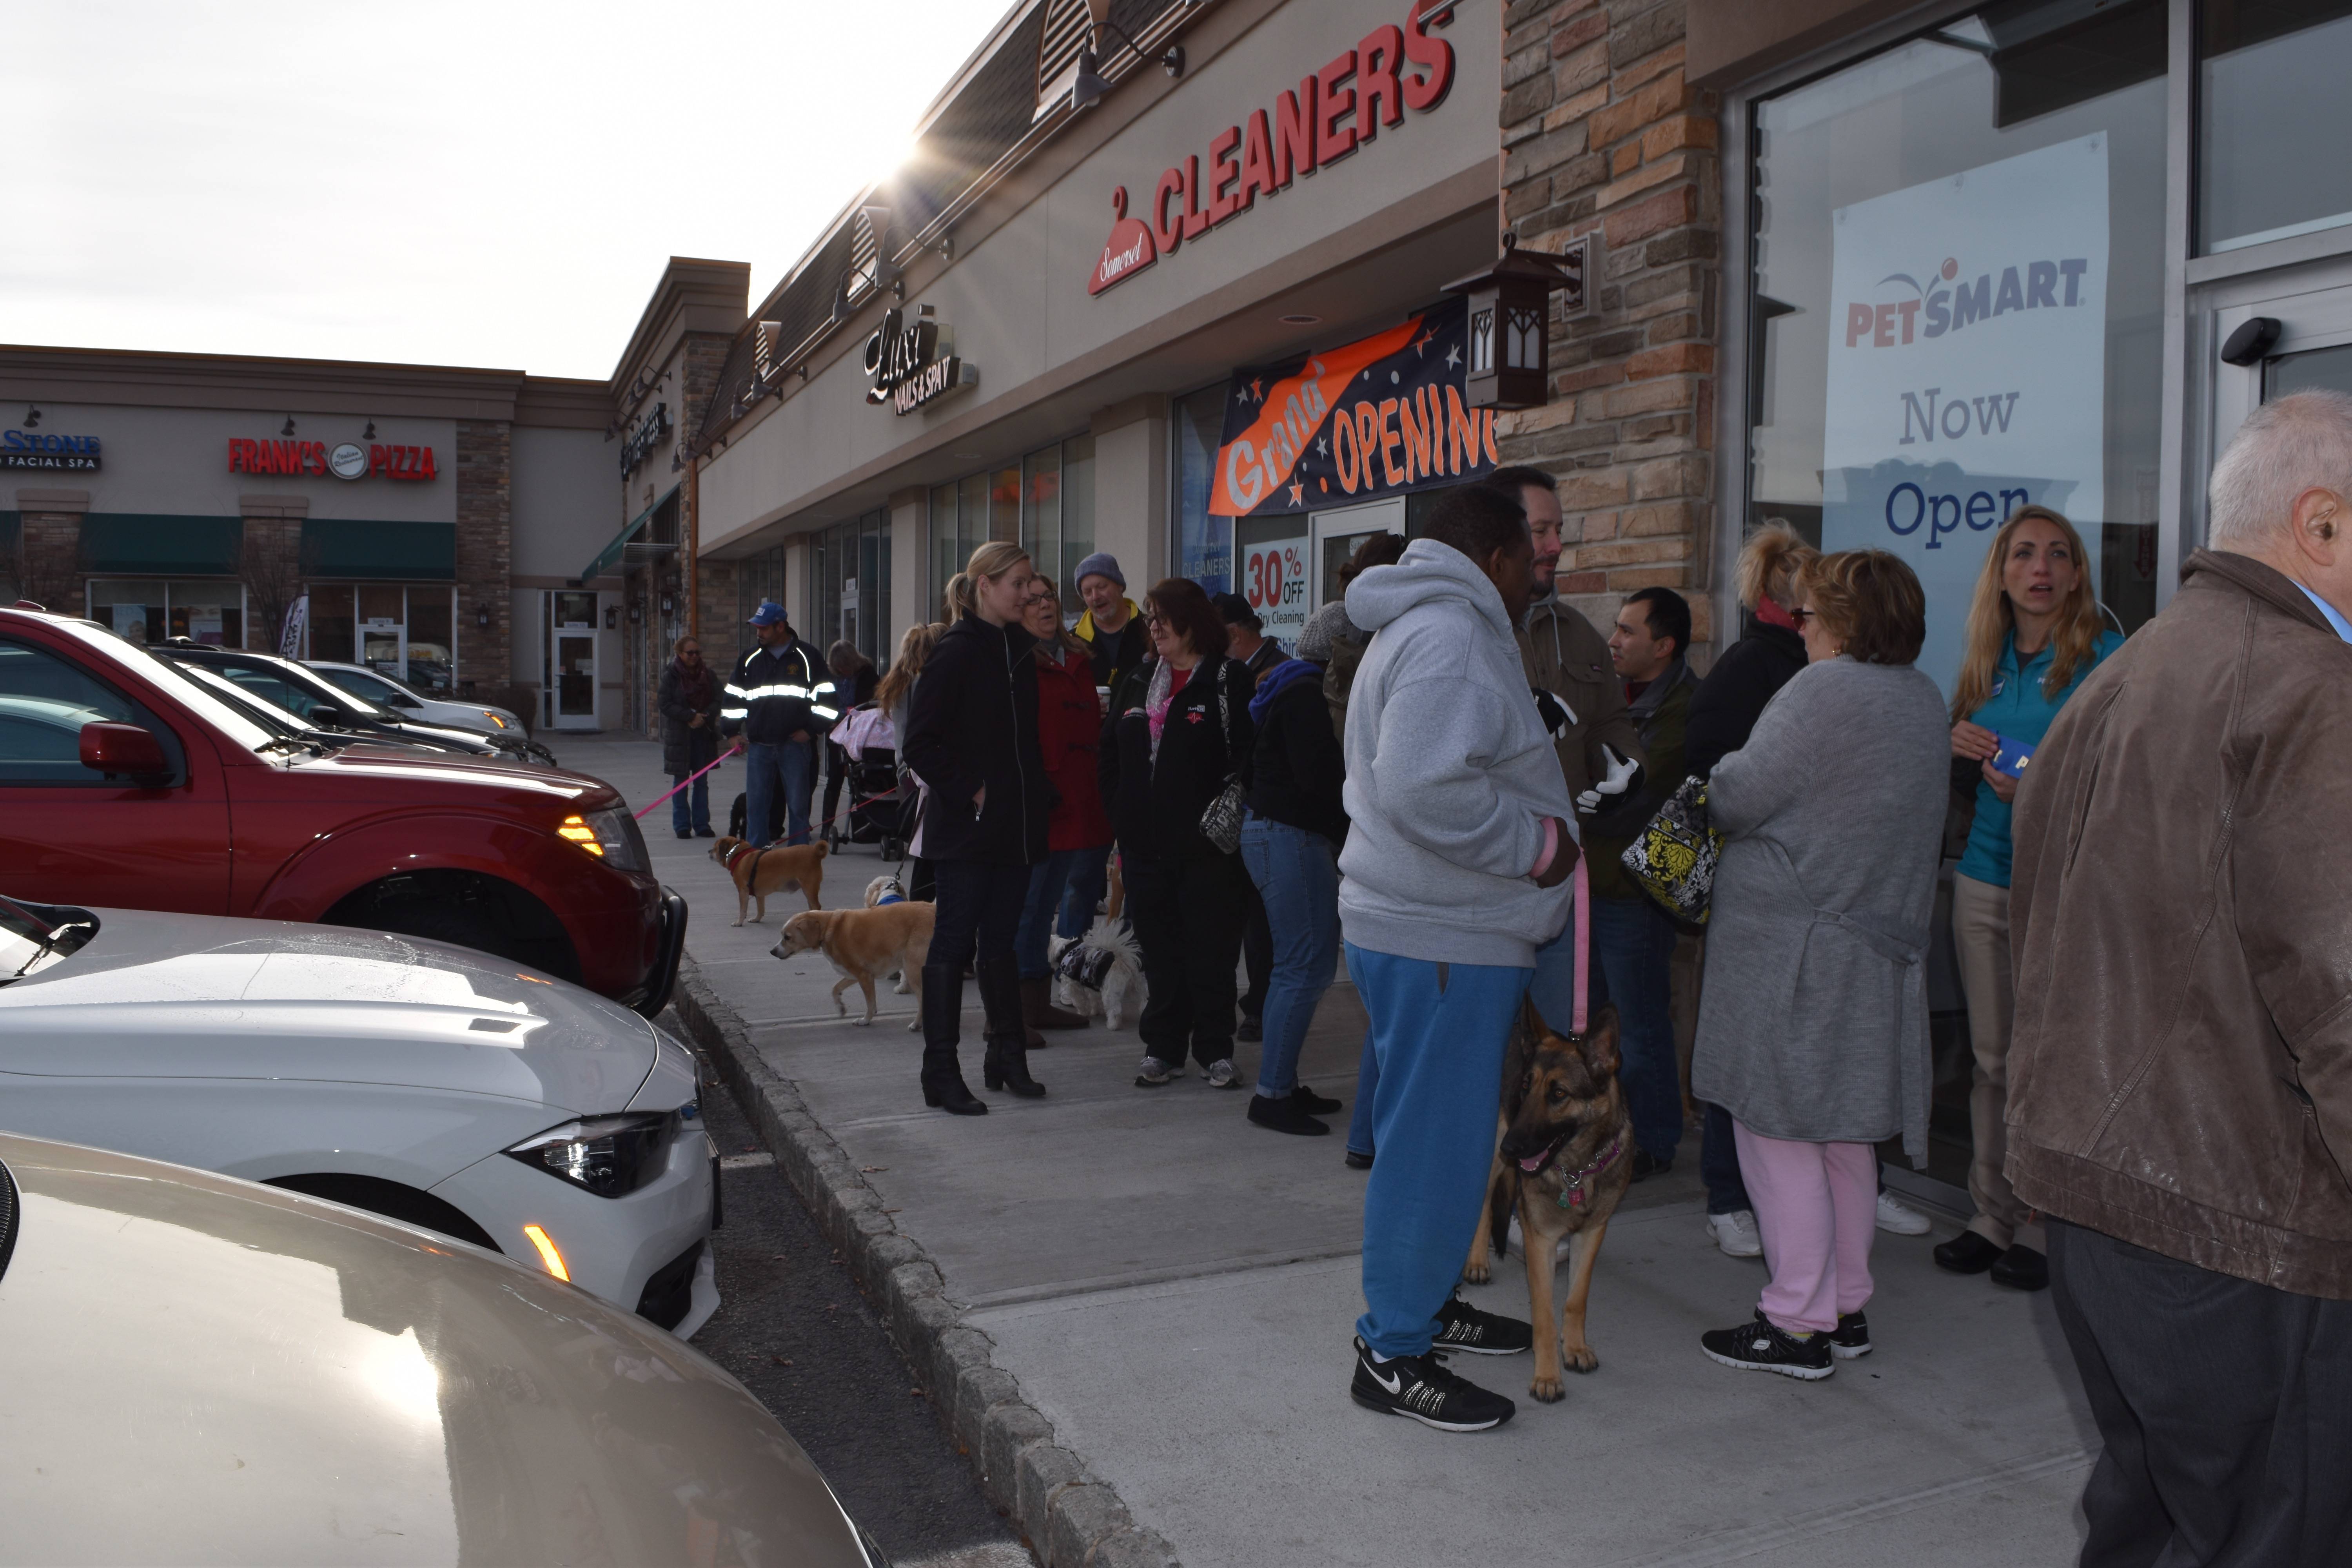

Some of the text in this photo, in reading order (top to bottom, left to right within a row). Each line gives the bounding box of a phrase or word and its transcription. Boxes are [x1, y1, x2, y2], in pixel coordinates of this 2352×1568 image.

[1153, 0, 1453, 255] CLEANERS
[1100, 232, 1142, 282] Somerset
[1846, 258, 2088, 348] PETSMART
[895, 376, 918, 416] NAILS
[918, 374, 925, 402] &
[926, 360, 942, 398] SPA
[1227, 359, 1327, 510] Grand
[1899, 387, 2019, 445] Now
[9, 457, 95, 468] FACIAL SPA
[229, 438, 327, 476] FRANK'S
[370, 444, 436, 481] PIZZA
[1886, 482, 2029, 549] Open
[1183, 557, 1230, 578] CLEANERS
[1283, 580, 1305, 605] OFF
[1258, 610, 1305, 628] Dry Cleaning
